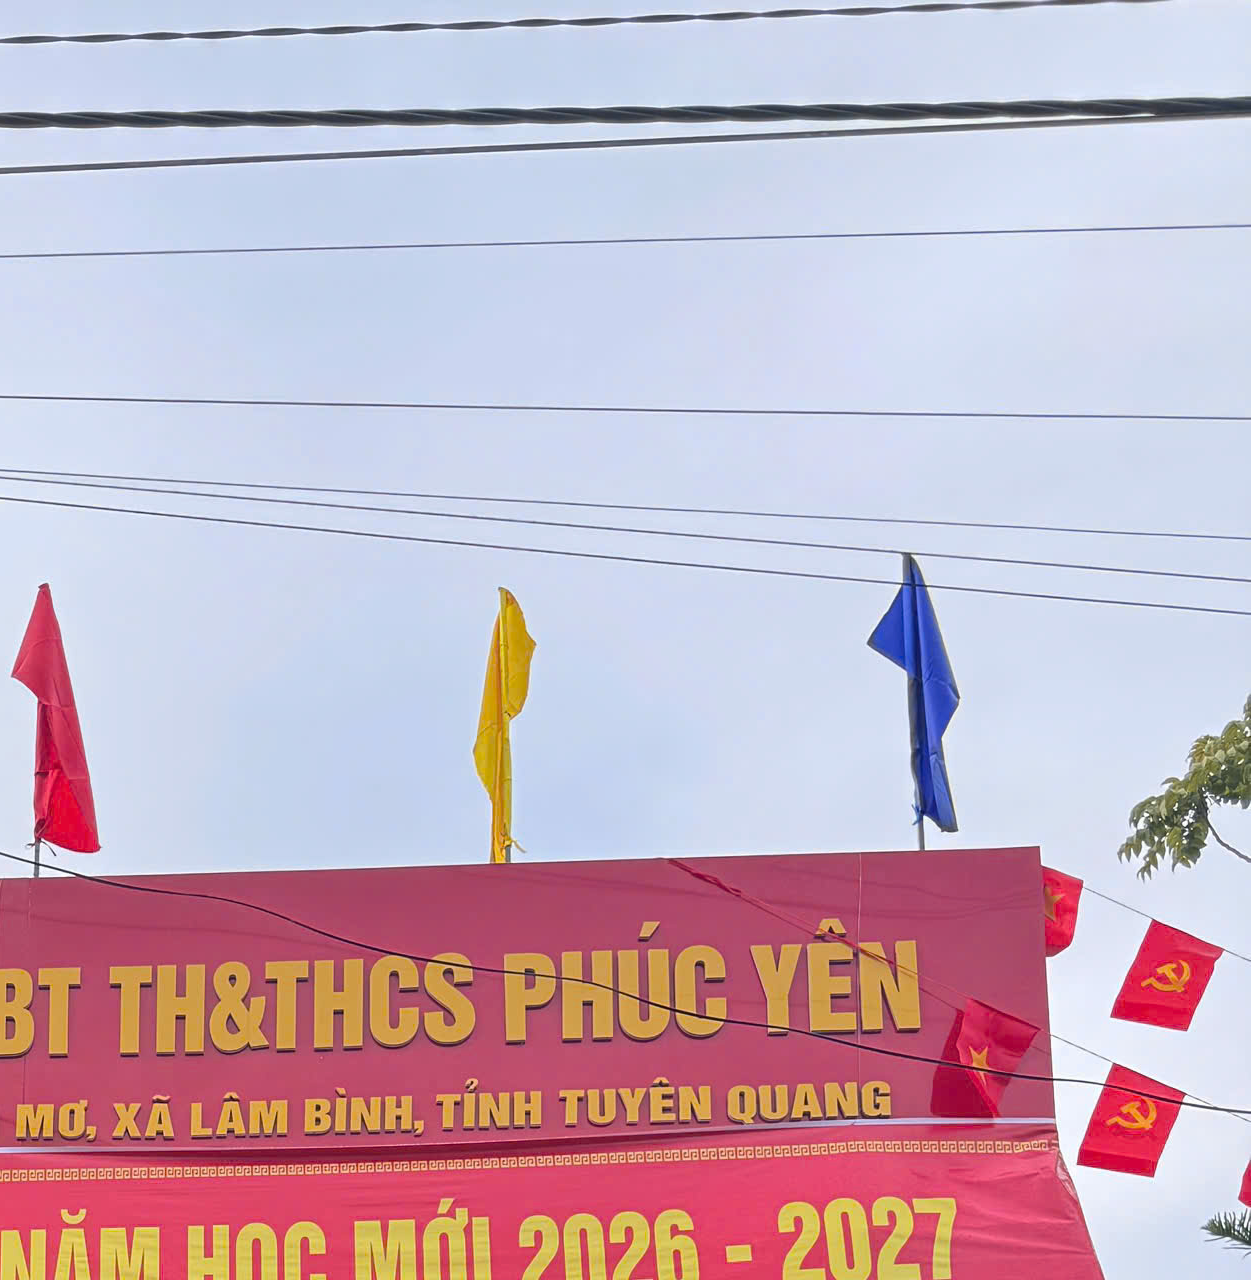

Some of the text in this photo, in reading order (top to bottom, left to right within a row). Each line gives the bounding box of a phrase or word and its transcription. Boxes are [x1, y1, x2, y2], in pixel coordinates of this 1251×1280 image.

[109, 954, 474, 1054] TH&THCS
[505, 922, 726, 1041] PHÚC
[752, 918, 920, 1032] YÊN
[16, 1101, 95, 1141] MƠ,
[114, 1095, 173, 1137] XÃ
[191, 1092, 287, 1136] LÂM
[305, 1087, 422, 1135] BÌNH,
[437, 1078, 541, 1128] TỈNH
[561, 1077, 710, 1124] TUYÊN
[728, 1081, 890, 1120] QUANG
[727, 1245, 751, 1262] -
